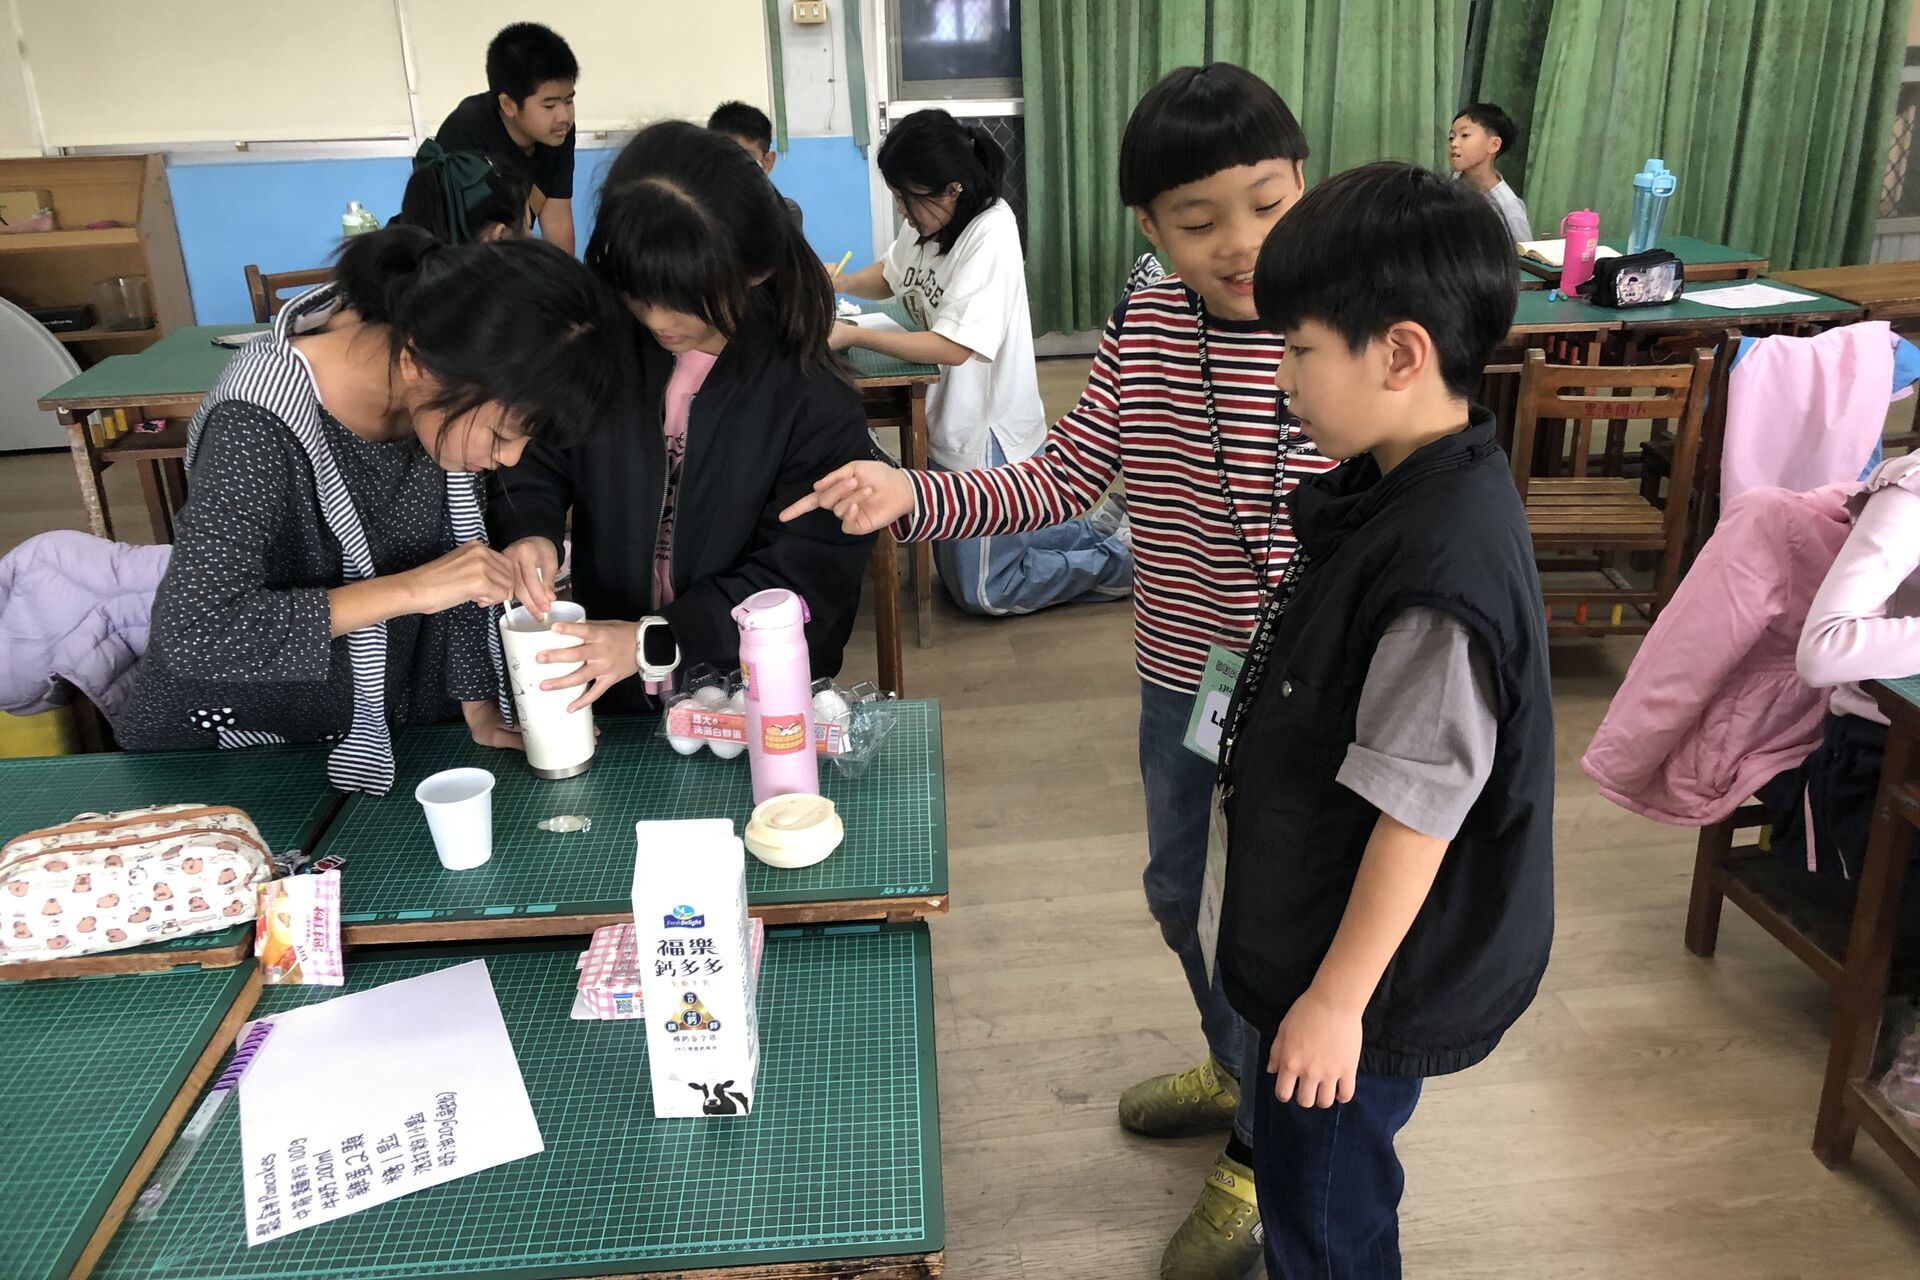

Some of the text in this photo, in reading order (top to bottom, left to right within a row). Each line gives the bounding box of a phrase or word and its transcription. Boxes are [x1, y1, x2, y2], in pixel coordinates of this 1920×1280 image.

[1280, 423, 1290, 440] NUK
[1283, 565, 1296, 583] NUK
[657, 938, 719, 956] 福樂
[655, 958, 724, 977] 鈣多多
